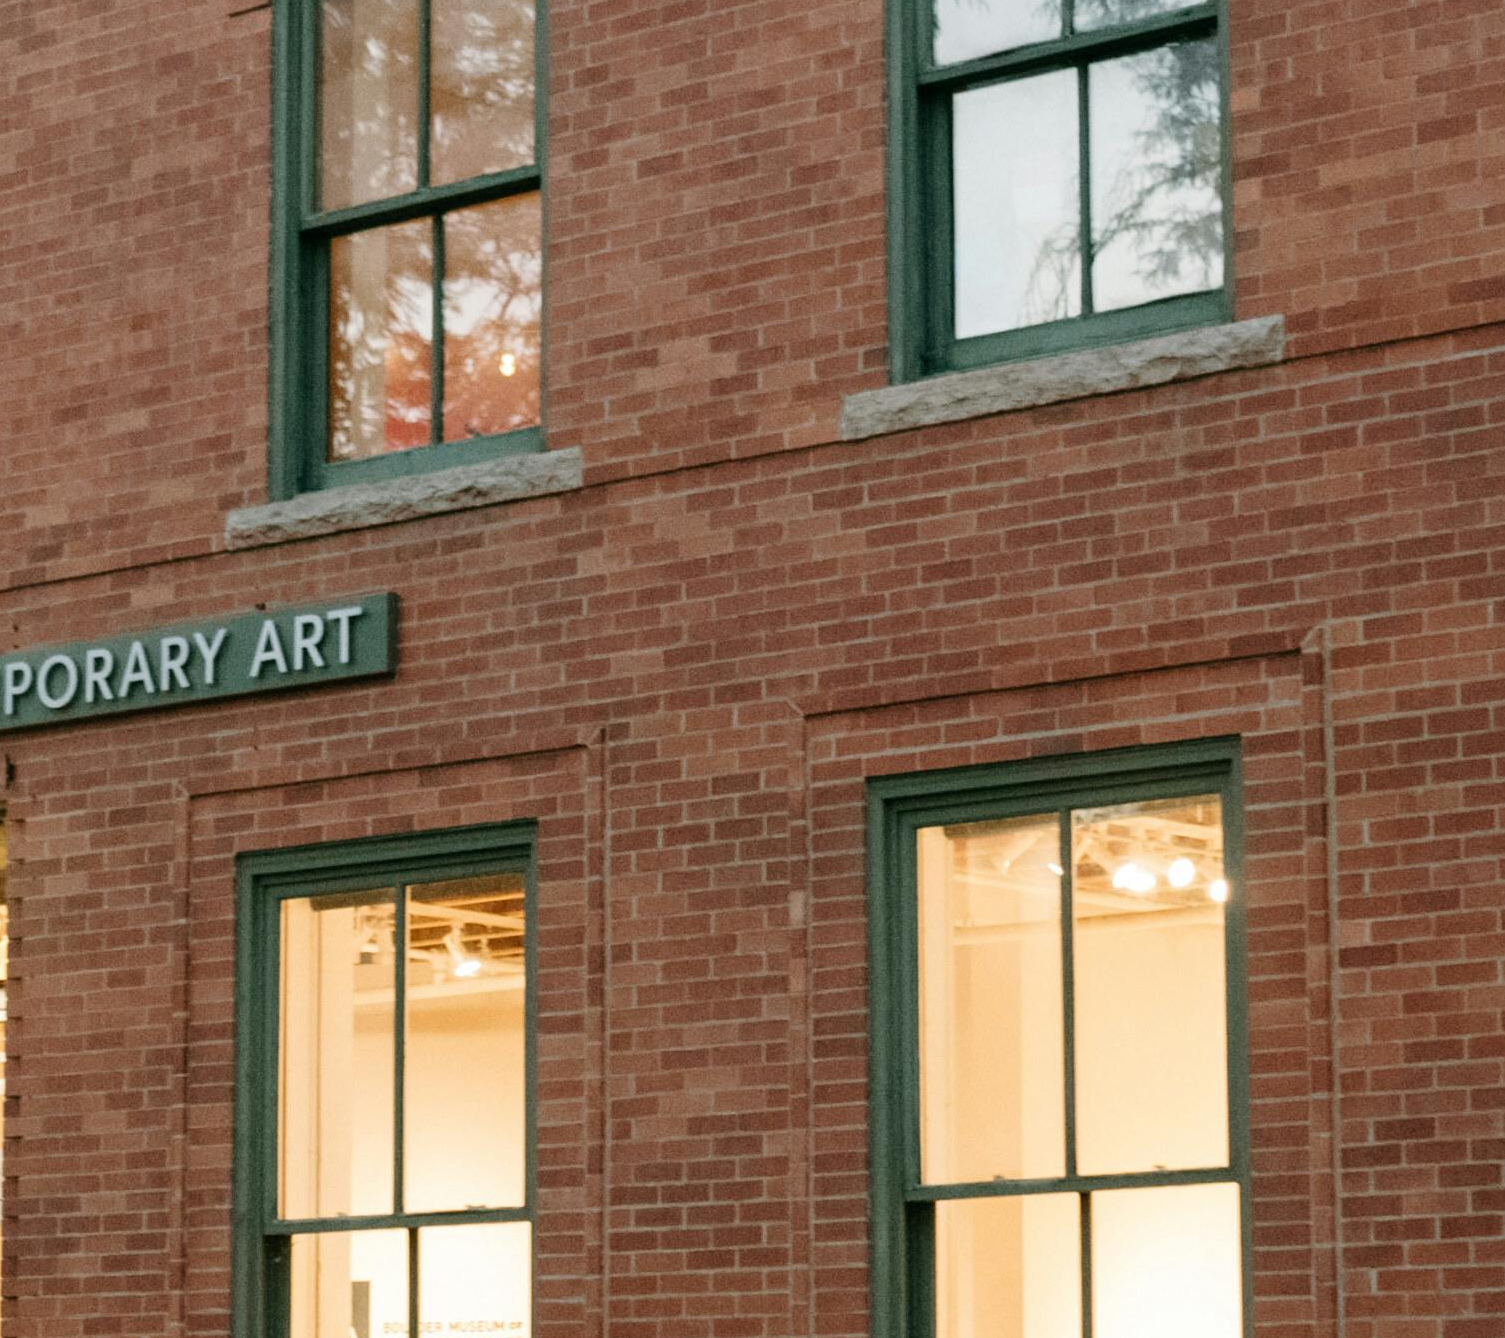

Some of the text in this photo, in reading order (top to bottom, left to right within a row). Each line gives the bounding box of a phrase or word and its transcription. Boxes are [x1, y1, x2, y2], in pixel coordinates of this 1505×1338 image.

[249, 606, 364, 678] ART
[382, 1321, 442, 1333] BOUDER
[448, 1320, 504, 1332] MUSEUM
